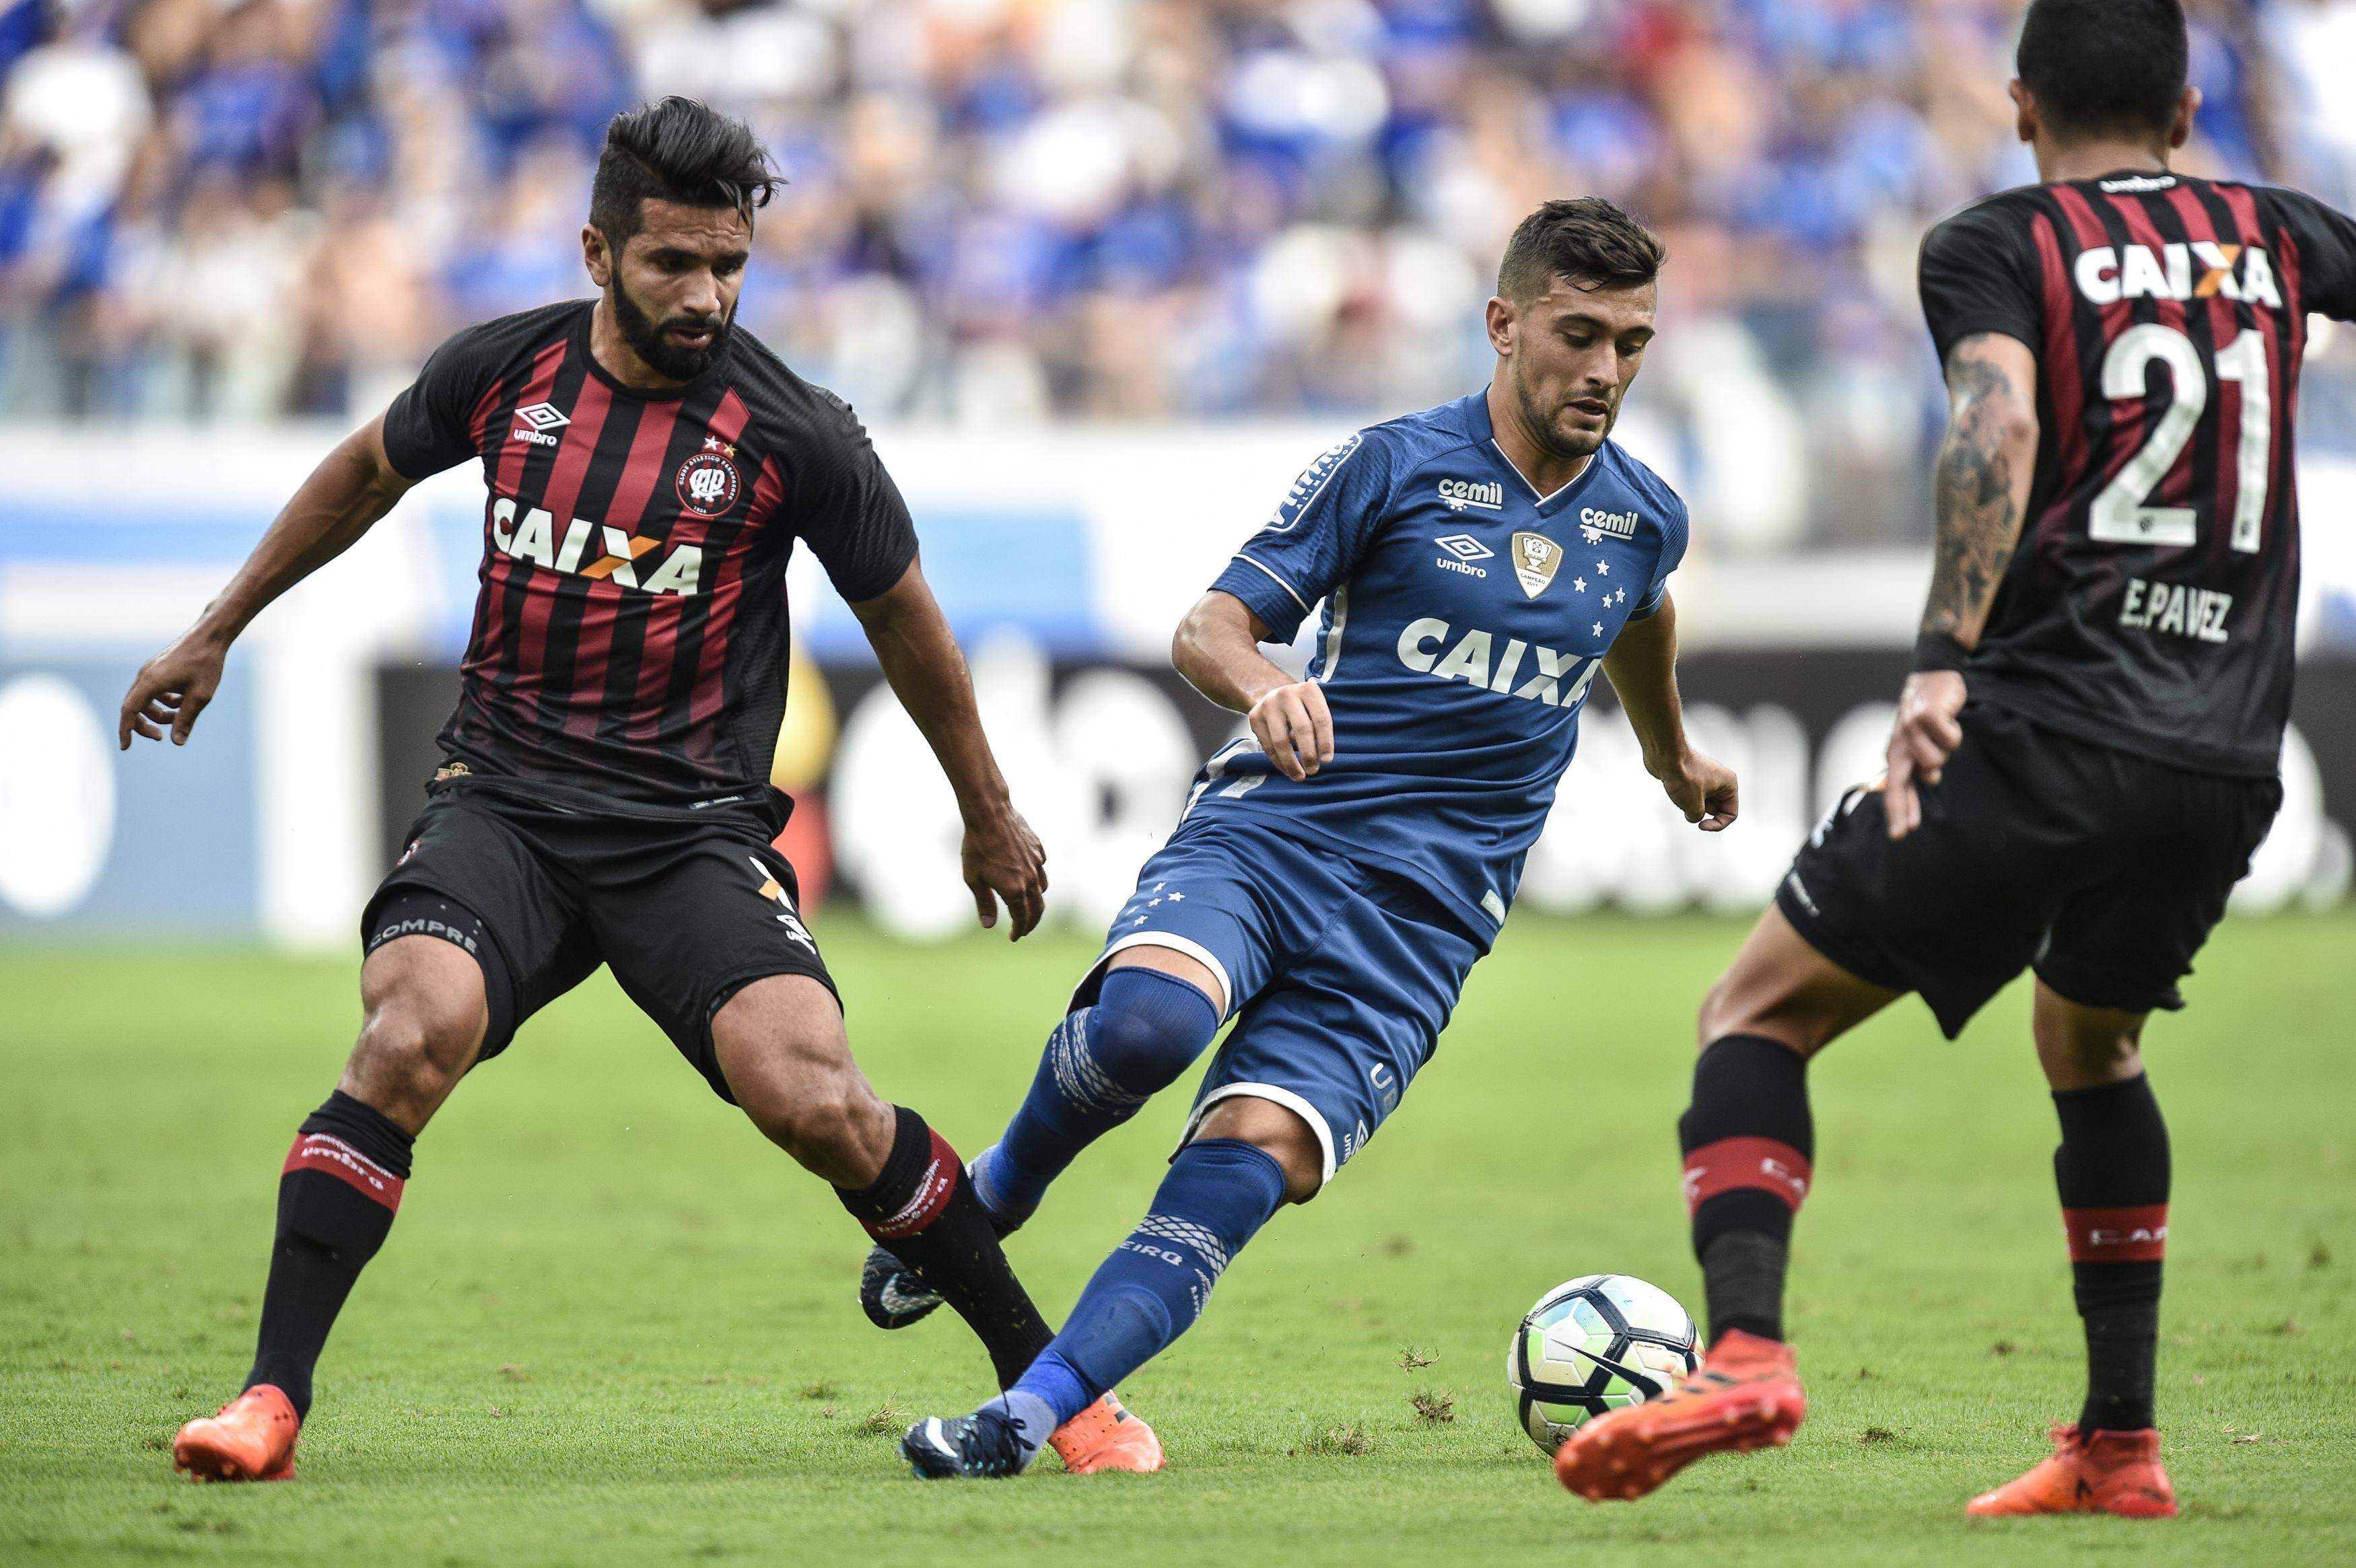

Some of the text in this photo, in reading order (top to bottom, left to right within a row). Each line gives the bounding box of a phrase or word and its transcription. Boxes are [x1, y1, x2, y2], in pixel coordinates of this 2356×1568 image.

[2075, 242, 2283, 309] CAIXA
[514, 429, 557, 447] umbro
[2089, 322, 2271, 554] 21
[1439, 478, 1503, 505] cemil
[1580, 507, 1638, 535] cemil
[492, 497, 703, 596] CAIXA
[1436, 557, 1487, 579] umbro
[1397, 617, 1602, 707] CAIXA
